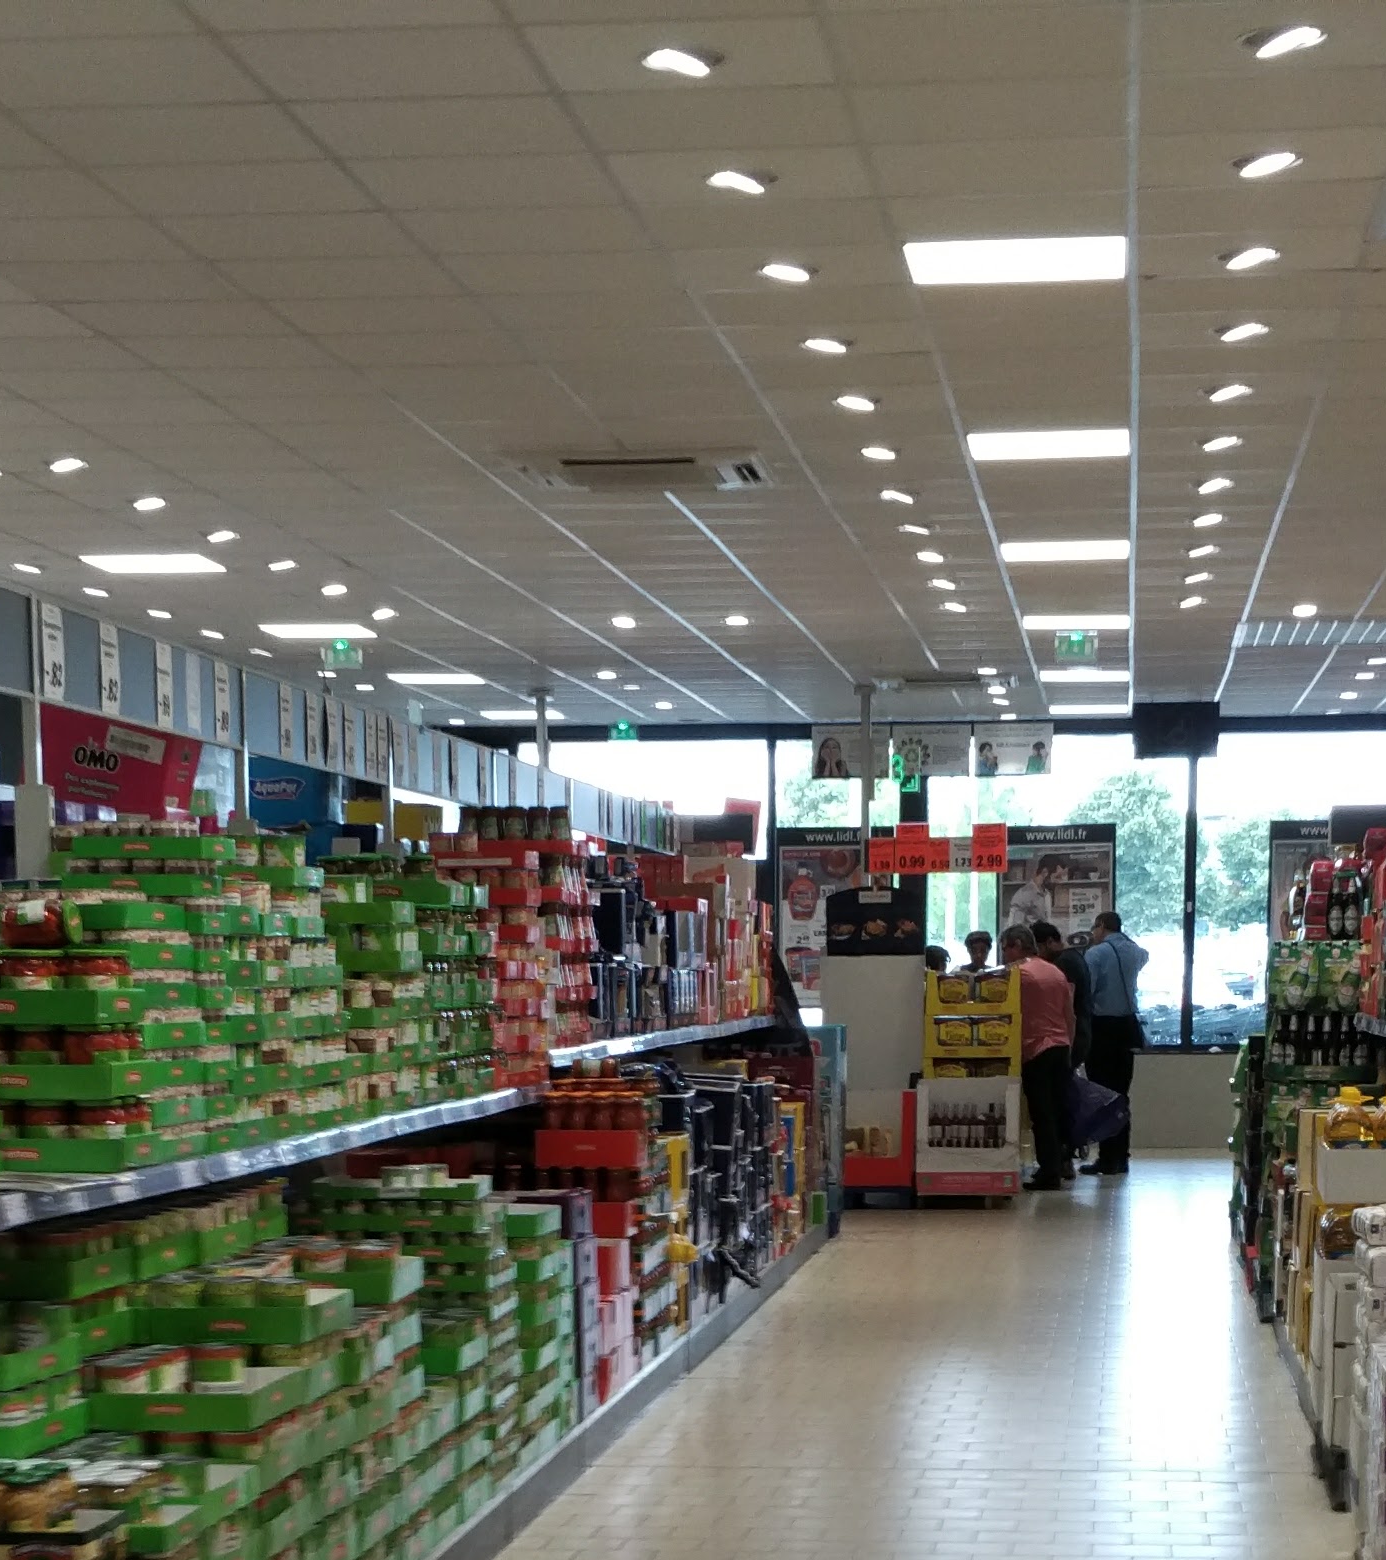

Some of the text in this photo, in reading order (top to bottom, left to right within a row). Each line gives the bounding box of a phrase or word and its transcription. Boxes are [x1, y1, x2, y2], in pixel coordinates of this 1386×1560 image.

[74, 746, 120, 772] OMO
[805, 829, 861, 843] www.lidl.f
[1025, 828, 1088, 841] www.lidl.fr
[899, 855, 926, 869] 0.99
[976, 854, 1003, 868] 2.99
